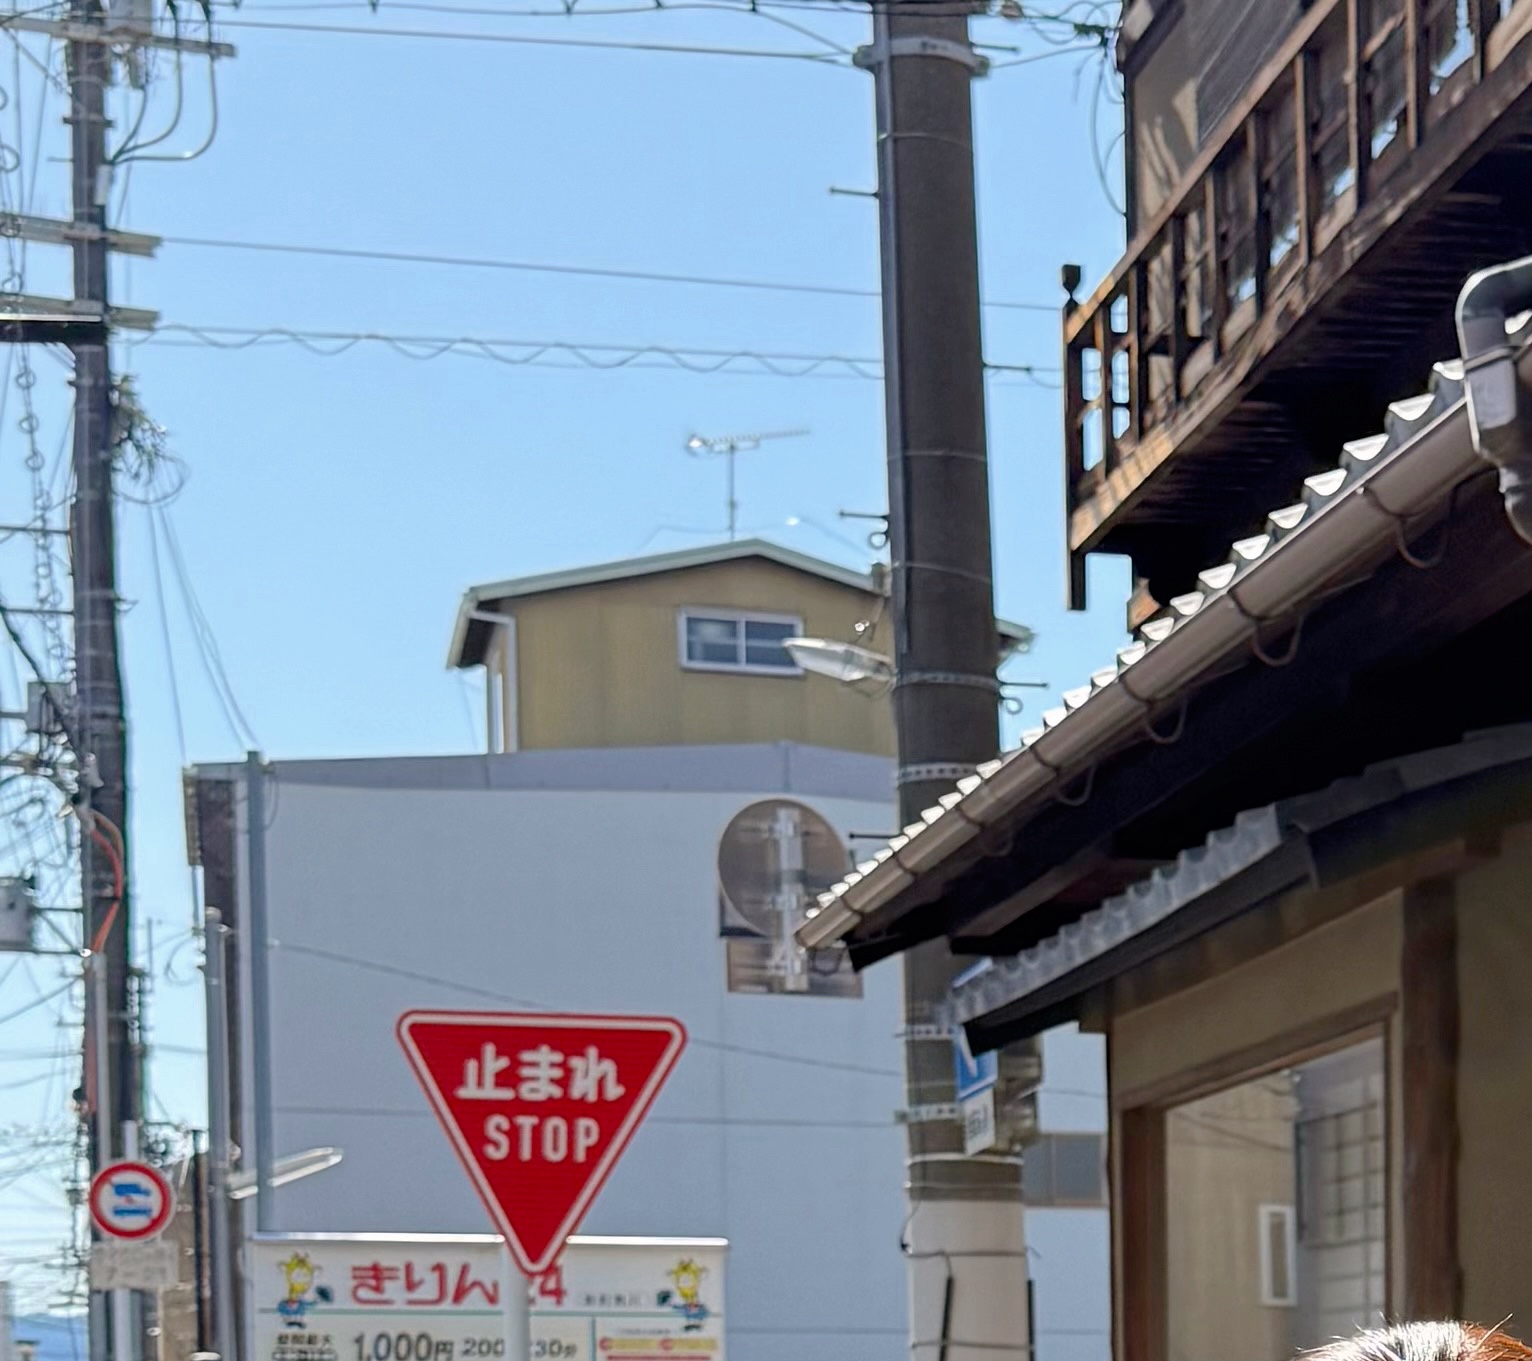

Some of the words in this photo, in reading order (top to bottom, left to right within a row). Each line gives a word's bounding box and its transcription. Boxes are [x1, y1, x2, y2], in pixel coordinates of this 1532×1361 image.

[454, 1042, 626, 1103] 止まれ
[482, 1113, 600, 1163] STOP
